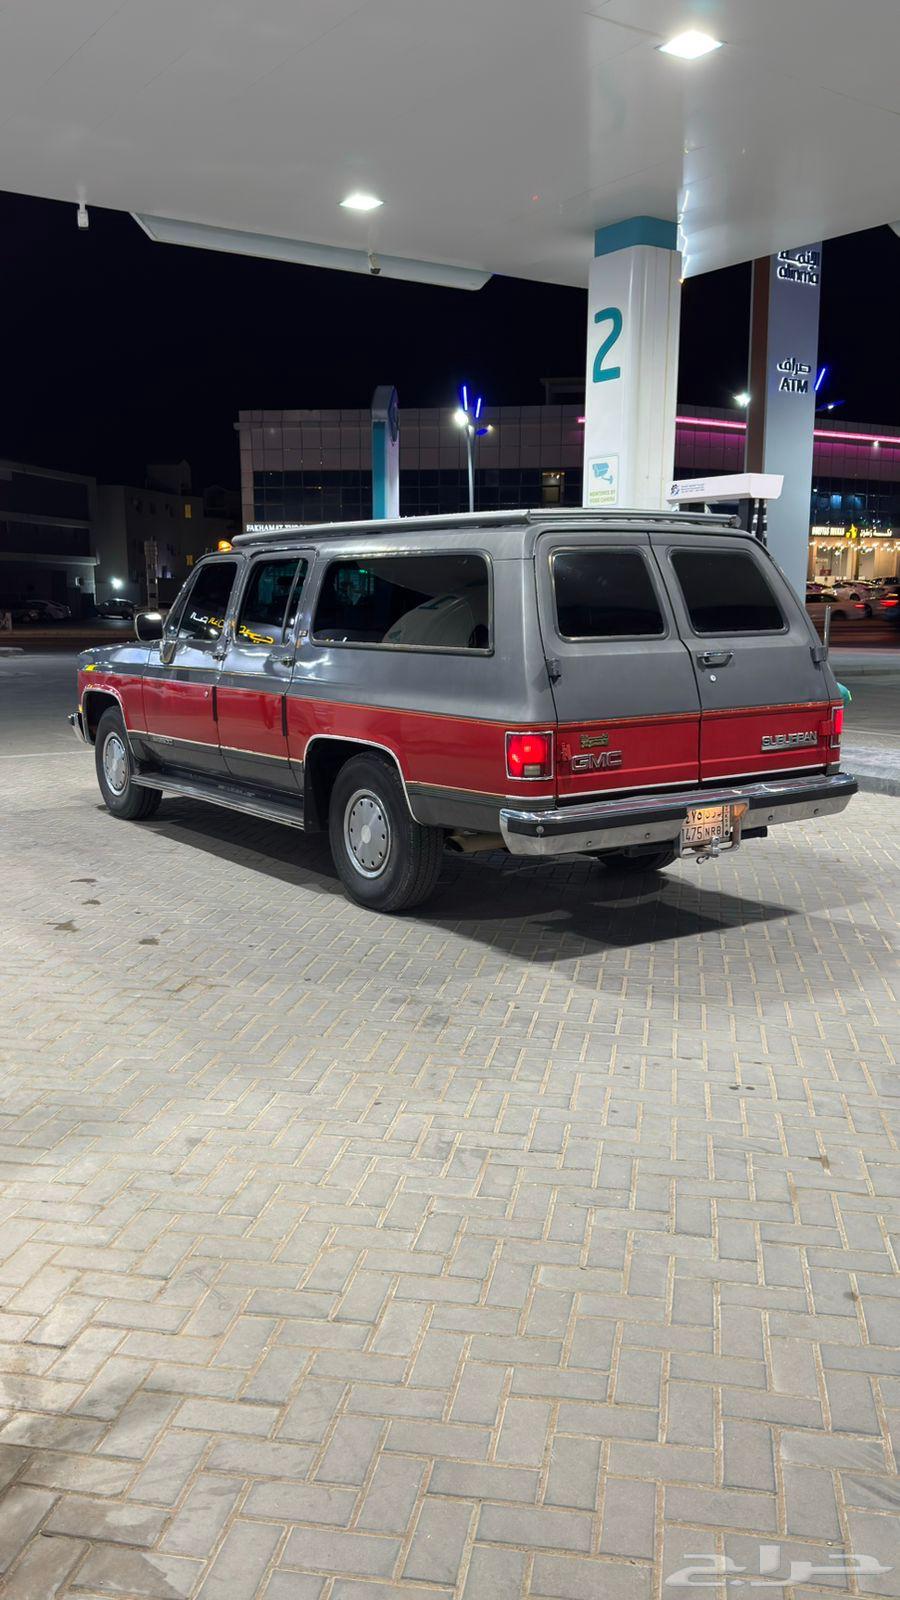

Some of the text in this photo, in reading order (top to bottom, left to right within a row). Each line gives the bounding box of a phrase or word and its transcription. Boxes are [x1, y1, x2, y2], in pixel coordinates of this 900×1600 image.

[593, 307, 622, 383] 2
[779, 377, 808, 394] ATM
[571, 750, 622, 771] GMC
